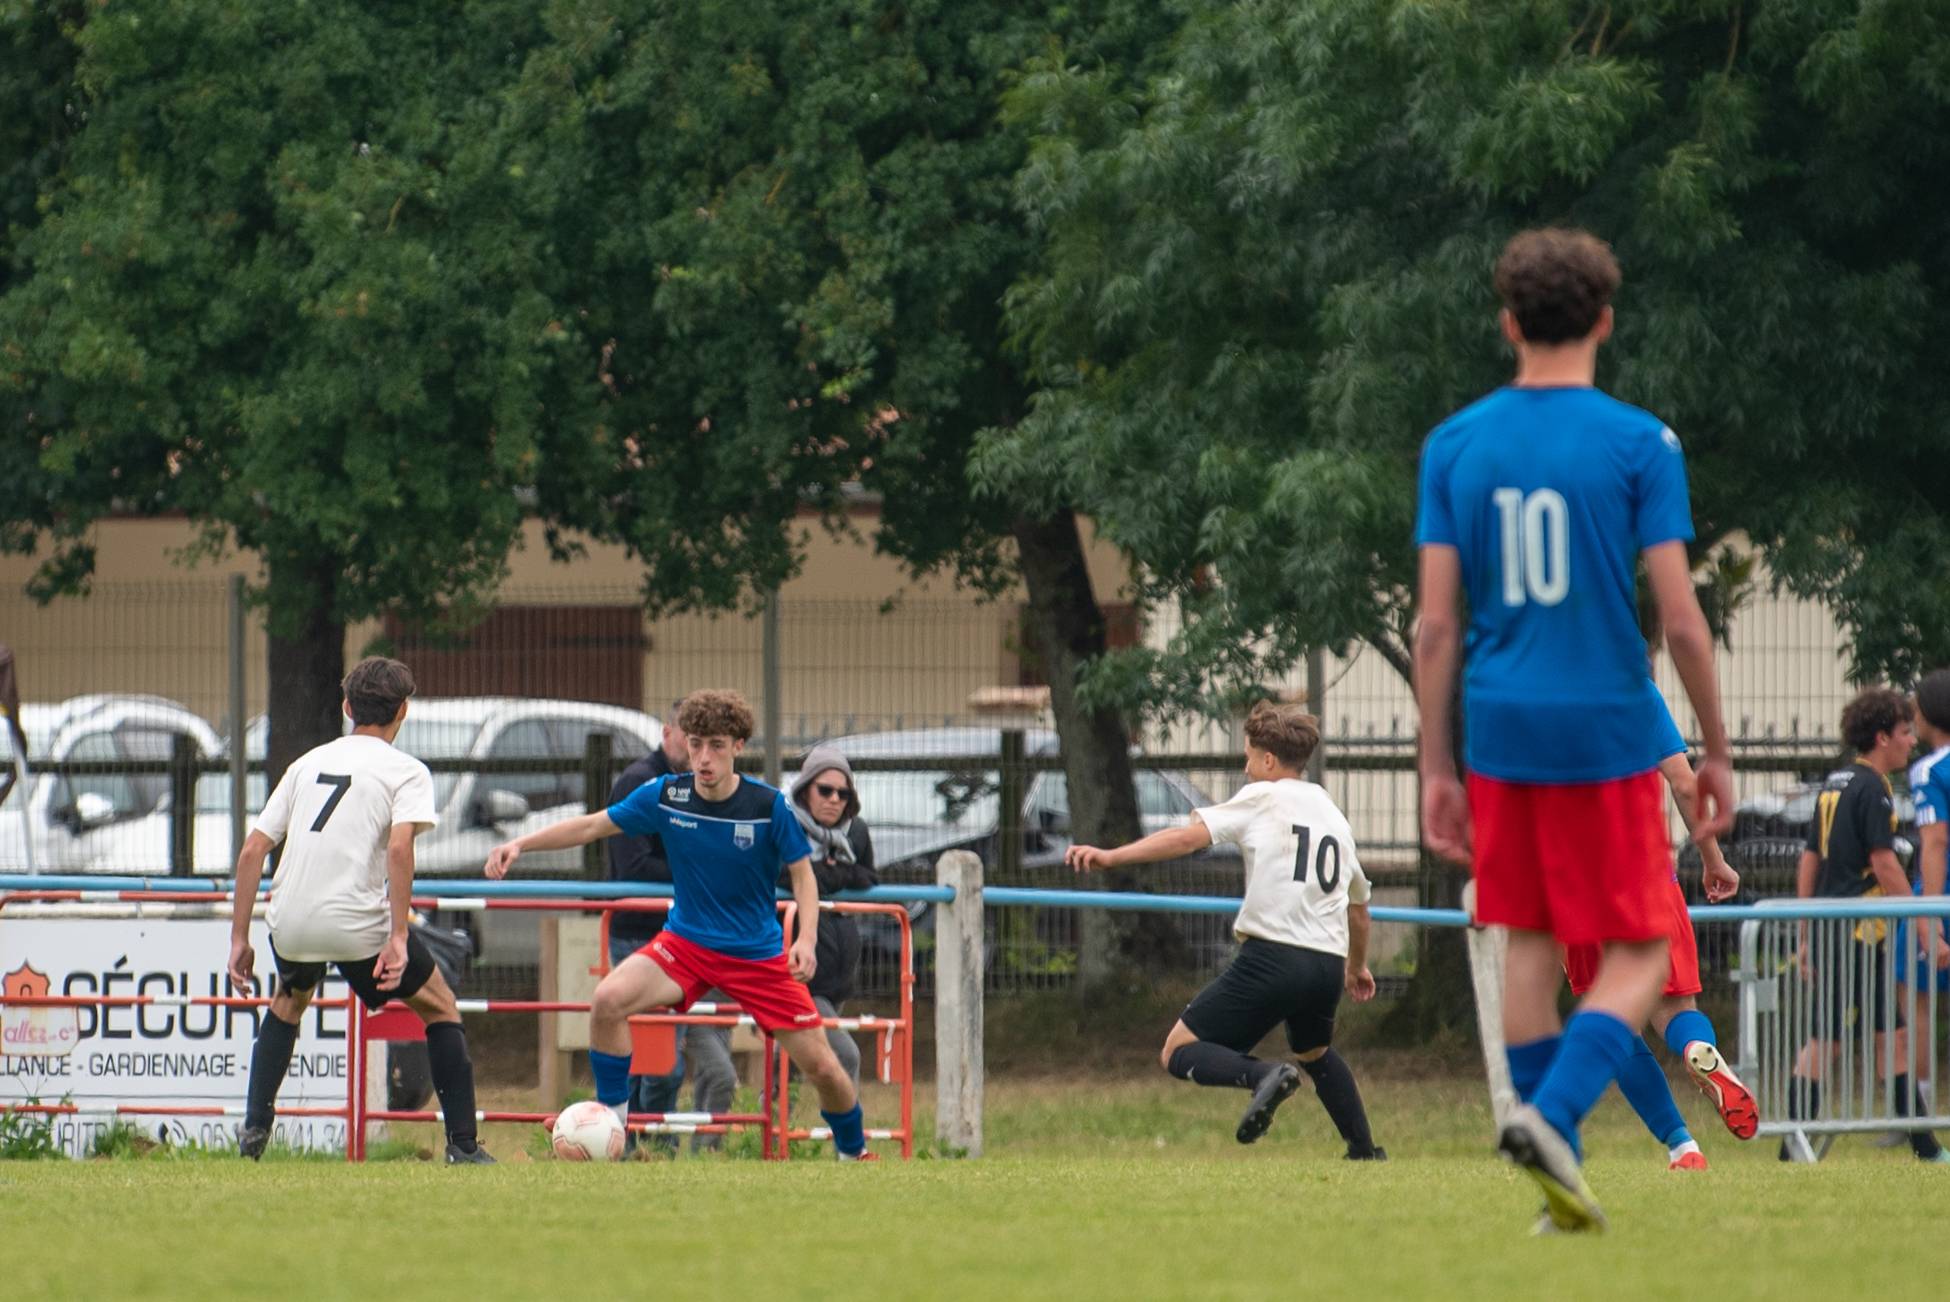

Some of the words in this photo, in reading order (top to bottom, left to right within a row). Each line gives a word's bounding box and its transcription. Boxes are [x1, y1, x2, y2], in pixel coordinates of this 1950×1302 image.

[1493, 487, 1570, 607] 10
[310, 772, 352, 832] 7
[1292, 824, 1341, 894] 10
[0, 1055, 71, 1076] LANCE
[89, 1053, 236, 1077] GARDIENNAGE
